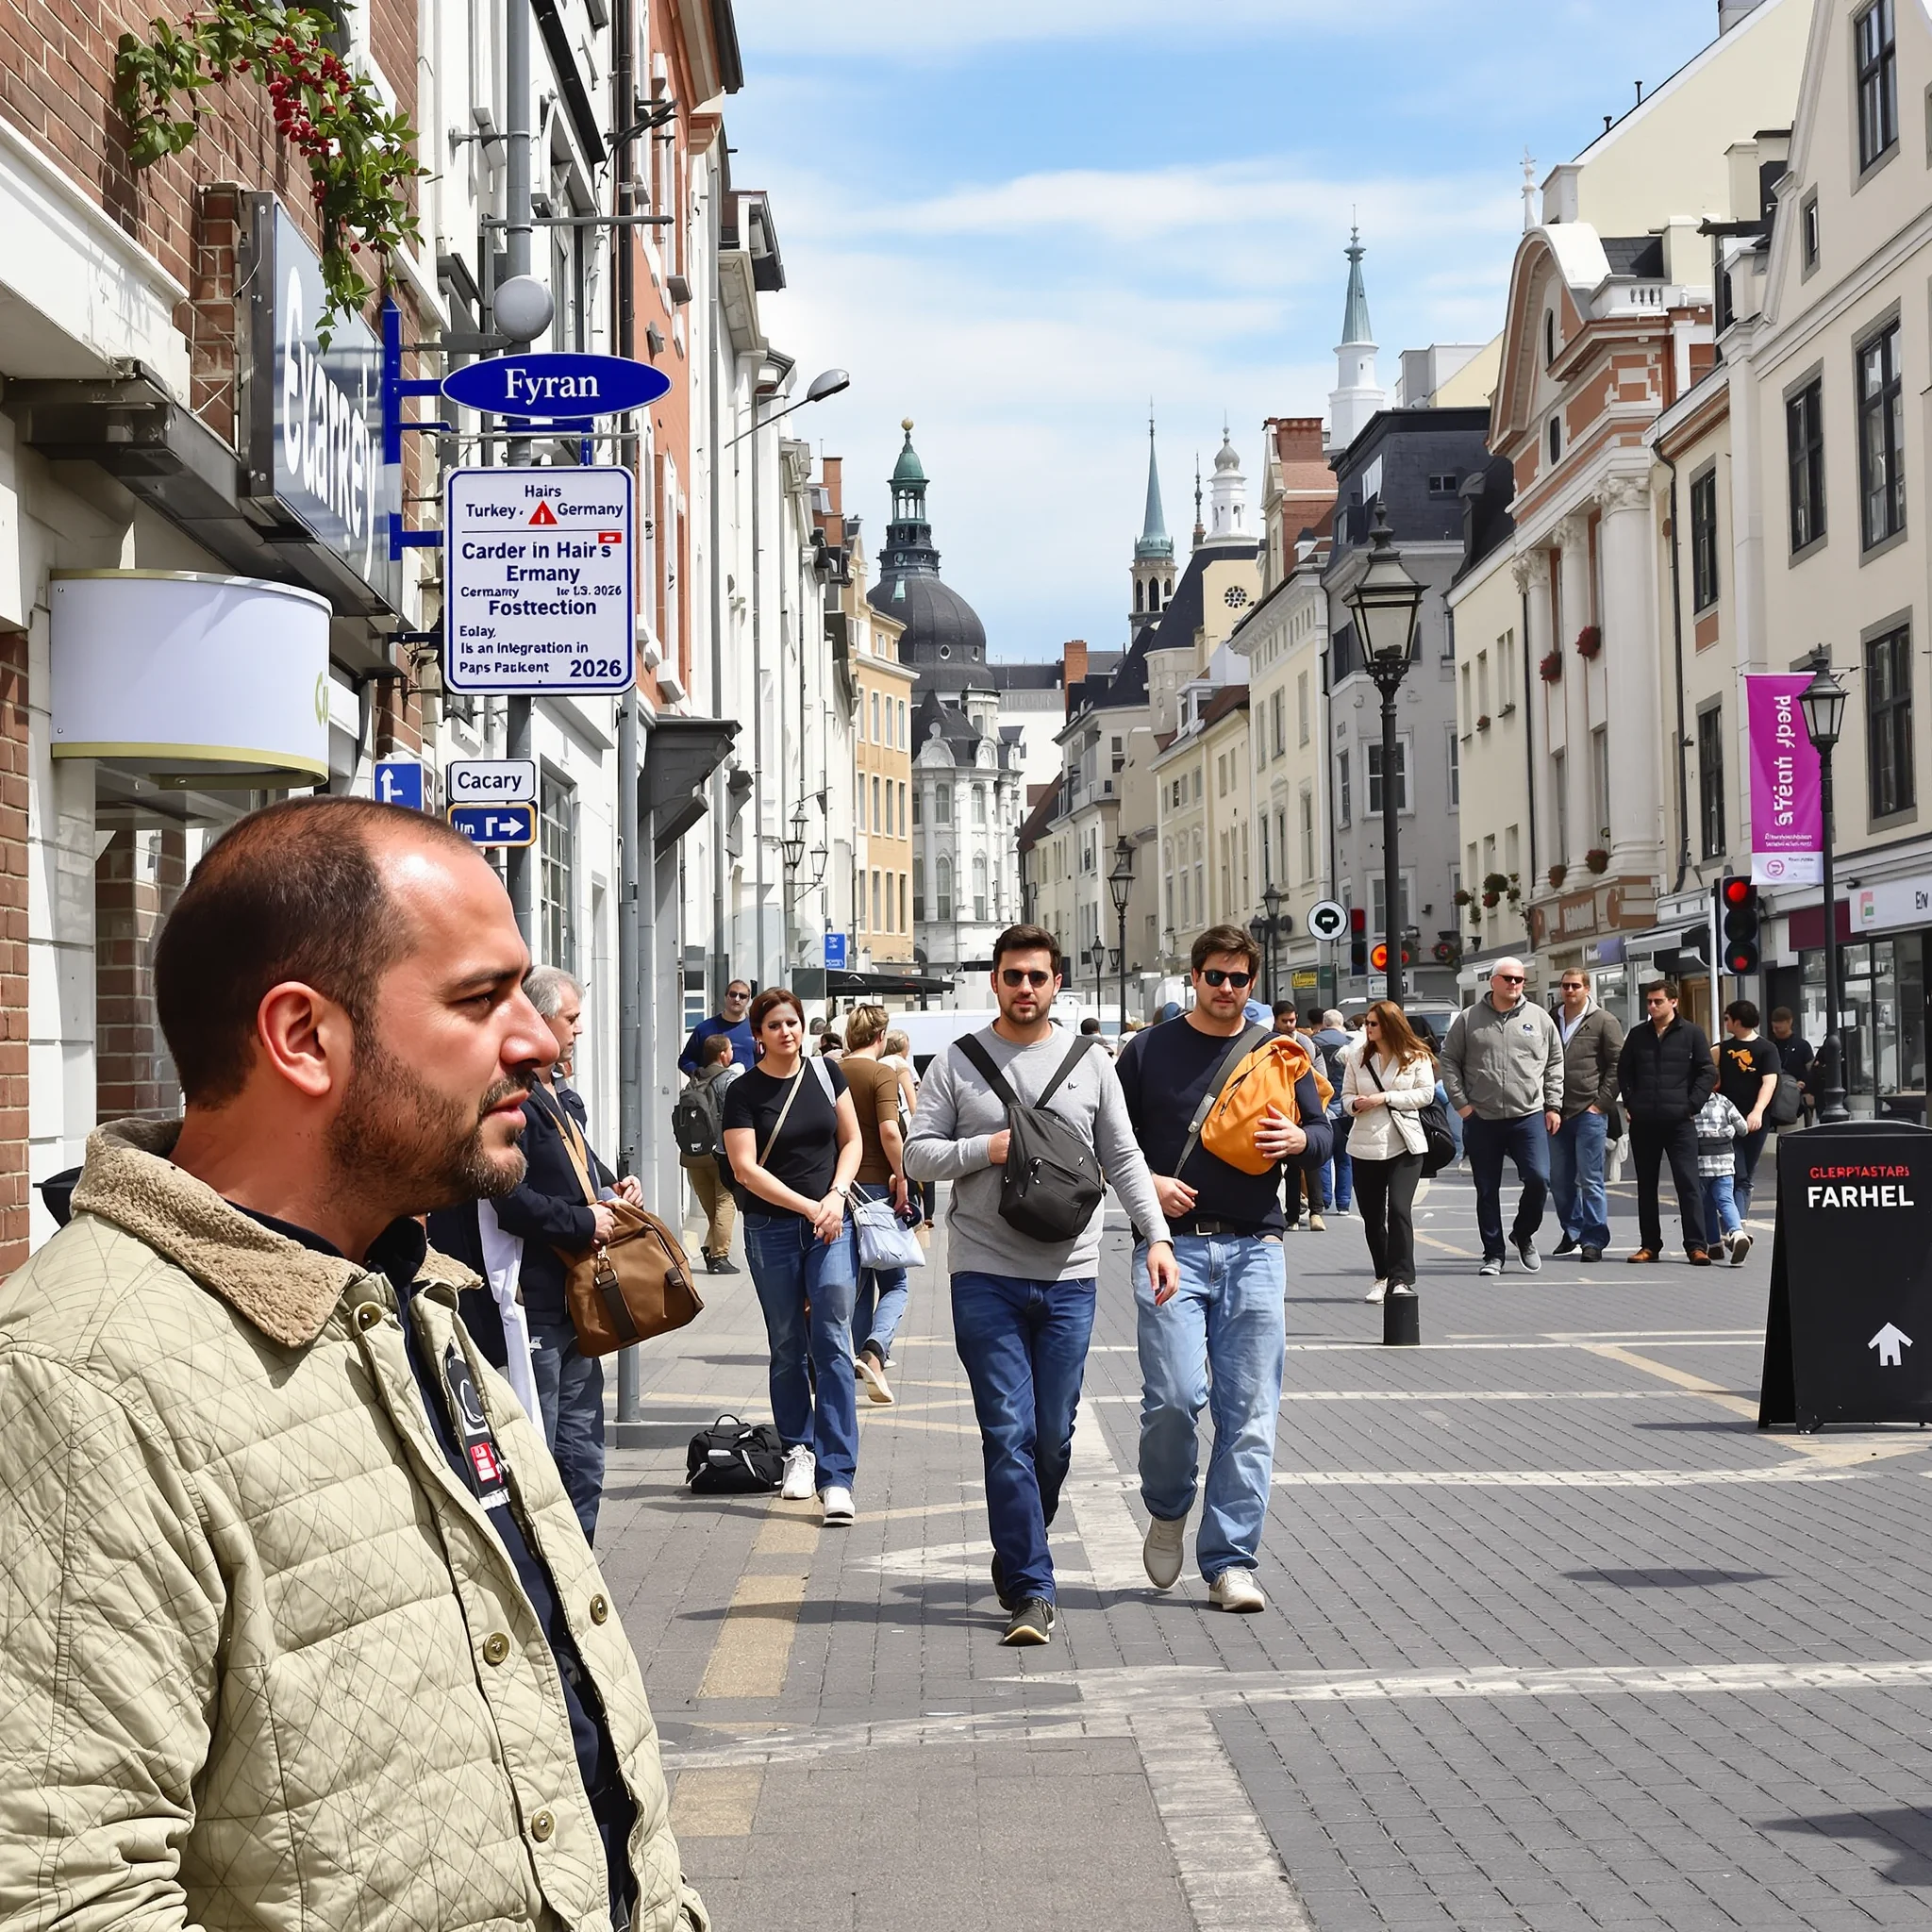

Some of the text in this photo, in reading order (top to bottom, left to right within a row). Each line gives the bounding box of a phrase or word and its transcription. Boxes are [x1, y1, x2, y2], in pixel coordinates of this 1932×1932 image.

[505, 369, 600, 405] Fyran
[525, 485, 561, 497] Hairs
[557, 503, 624, 518] Germany
[461, 542, 525, 558] Carder
[533, 541, 549, 558] in
[507, 565, 580, 584] Ermany
[477, 644, 493, 654] an
[576, 641, 589, 653] in
[569, 659, 622, 677] 2026
[458, 772, 523, 791] Cacary
[1807, 1185, 1915, 1208] FARHEL
